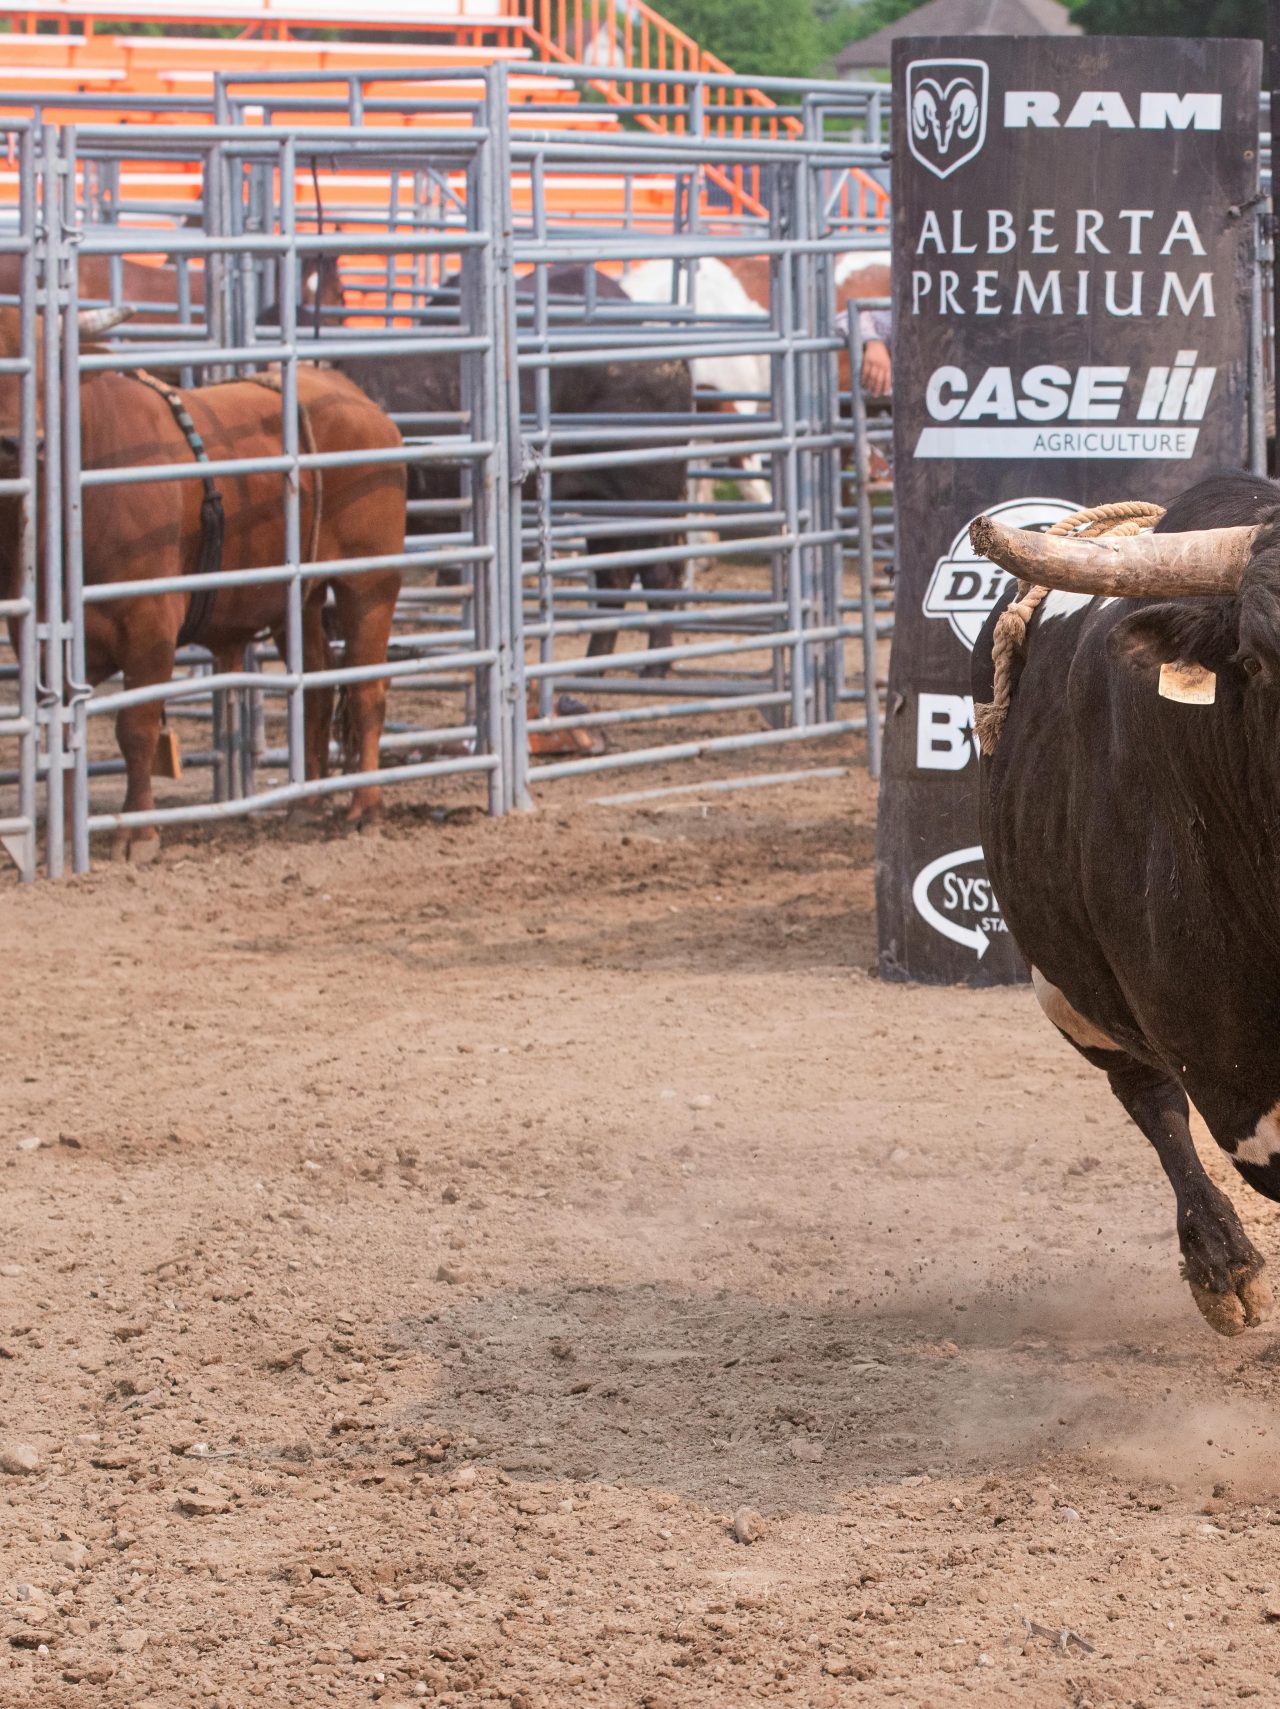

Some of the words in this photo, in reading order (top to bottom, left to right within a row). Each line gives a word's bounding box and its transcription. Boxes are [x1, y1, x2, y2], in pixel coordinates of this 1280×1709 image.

[1003, 91, 1223, 131] RAM
[915, 209, 1208, 256] ALBERTA
[911, 270, 1216, 318] PREMIUM
[925, 364, 1131, 421] CASE
[1033, 433, 1187, 453] AGRICULTURE
[944, 568, 1017, 601] Di
